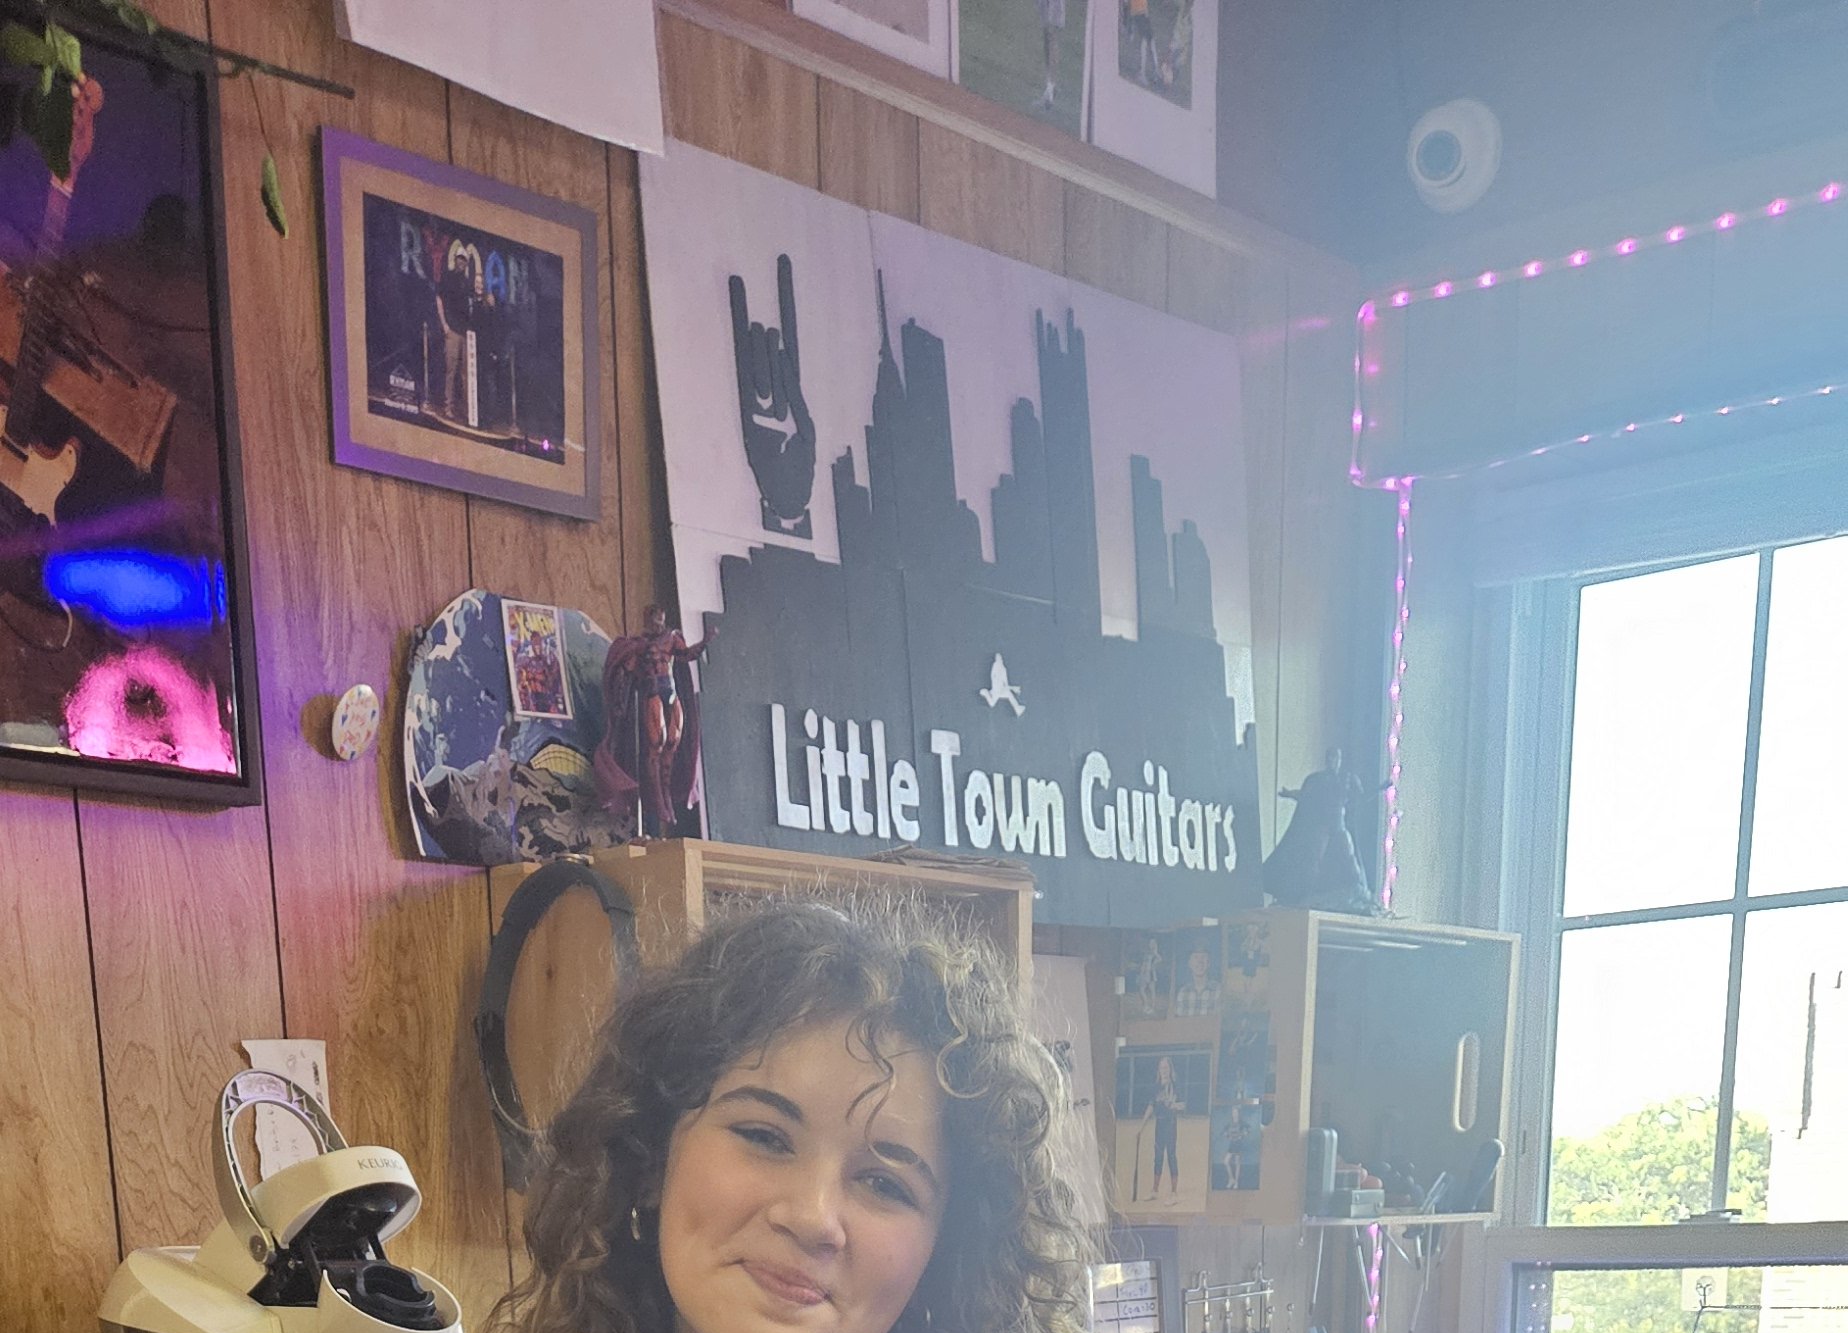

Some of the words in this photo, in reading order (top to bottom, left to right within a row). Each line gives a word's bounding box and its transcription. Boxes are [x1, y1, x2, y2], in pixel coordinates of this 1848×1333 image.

[401, 221, 531, 305] RYMAN
[770, 703, 921, 842] Little
[931, 729, 1066, 858] Town
[1080, 750, 1236, 873] Guitars
